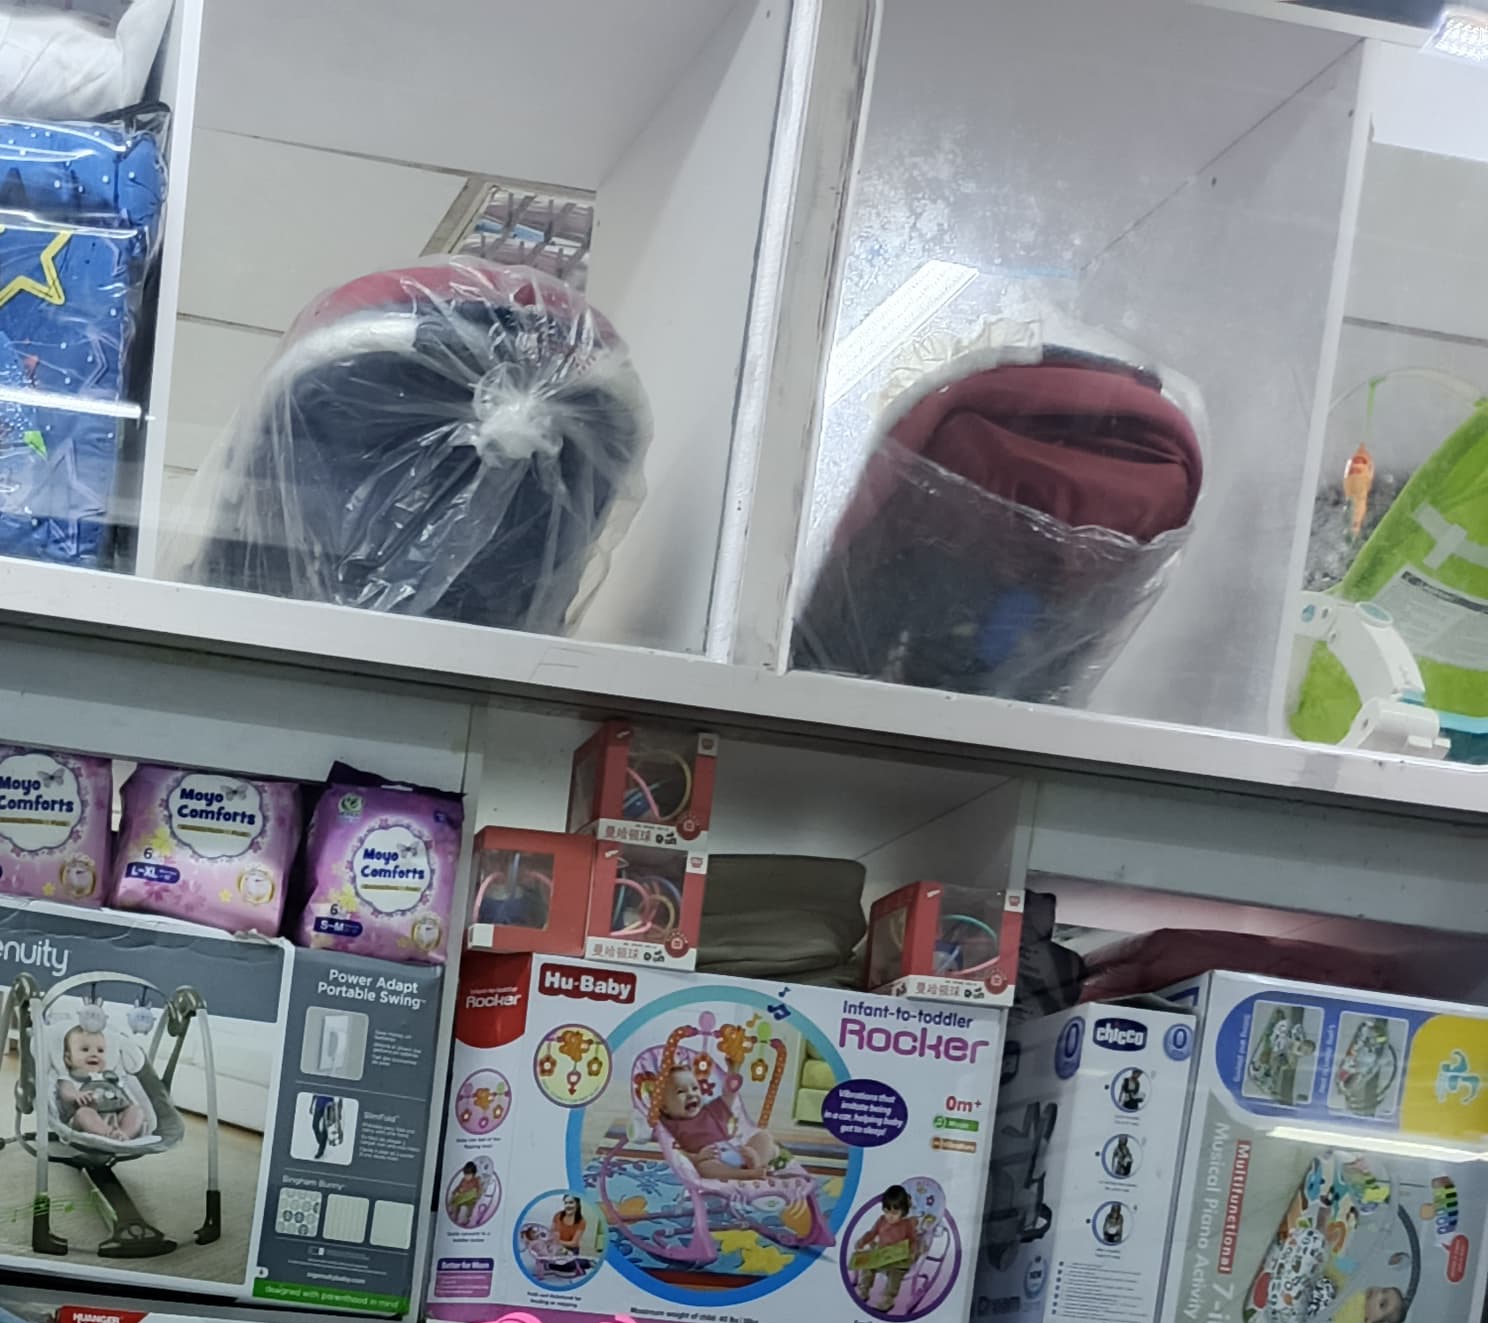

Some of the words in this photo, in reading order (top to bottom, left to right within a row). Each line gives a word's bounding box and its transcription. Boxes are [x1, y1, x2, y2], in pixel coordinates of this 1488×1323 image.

[180, 788, 224, 807] Moyo
[177, 804, 256, 826] Comforts
[143, 847, 153, 859] 6
[363, 847, 399, 865] Moyo
[361, 865, 425, 880] Comforts
[330, 903, 338, 916] 6
[329, 968, 373, 986] Power
[376, 977, 419, 994] Adapt
[544, 970, 632, 999] Hu-Baby
[317, 981, 376, 1001] Portable
[379, 990, 422, 1010] Swing
[465, 993, 522, 1009] Rocker
[842, 1000, 975, 1029] Infant-to-toddler
[839, 1017, 990, 1064] Rocker
[1095, 1022, 1145, 1047] chicco
[1205, 1122, 1231, 1193] Musical
[1220, 1143, 1251, 1274] Multifunctional
[1198, 1198, 1224, 1249] Piano
[1182, 1253, 1210, 1320] Activity
